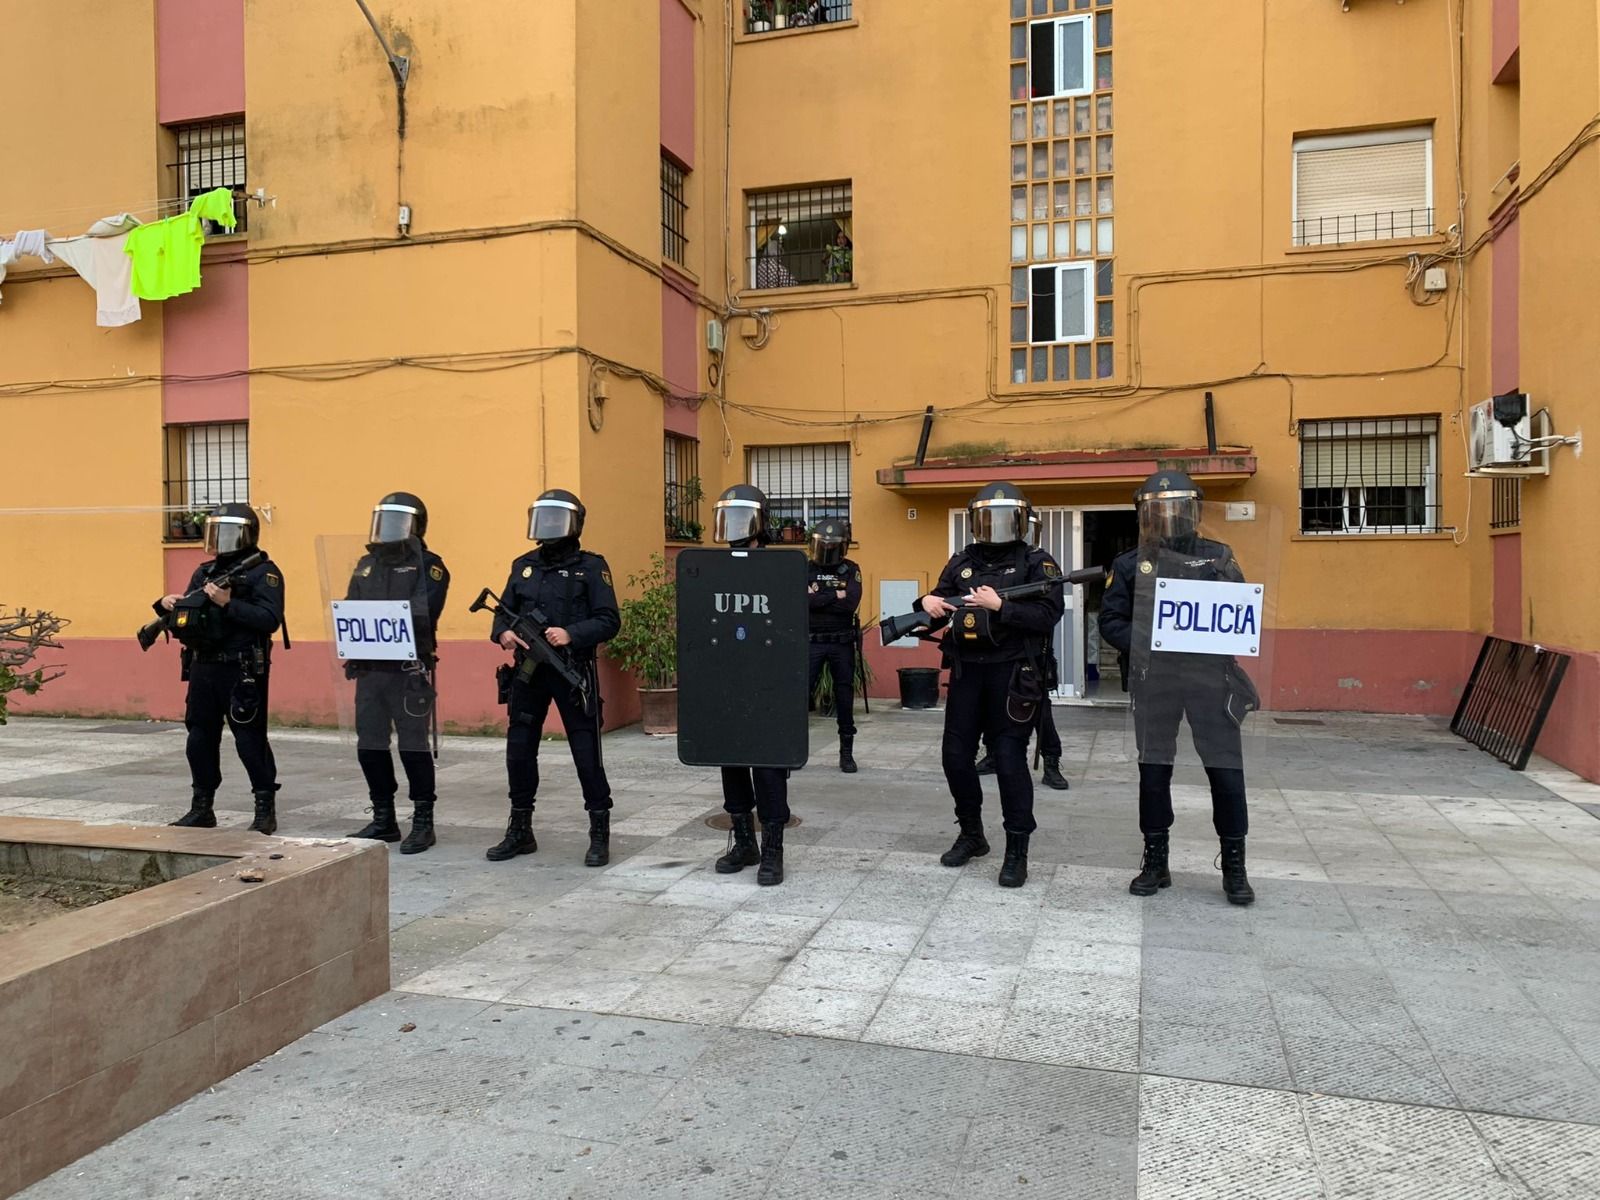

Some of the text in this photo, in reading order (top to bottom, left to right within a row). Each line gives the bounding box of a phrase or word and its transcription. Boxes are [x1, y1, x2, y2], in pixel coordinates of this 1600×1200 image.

[1242, 506, 1249, 516] 3
[713, 593, 771, 614] UPR
[1157, 600, 1256, 635] POLICIA
[336, 618, 411, 643] POLICIA
